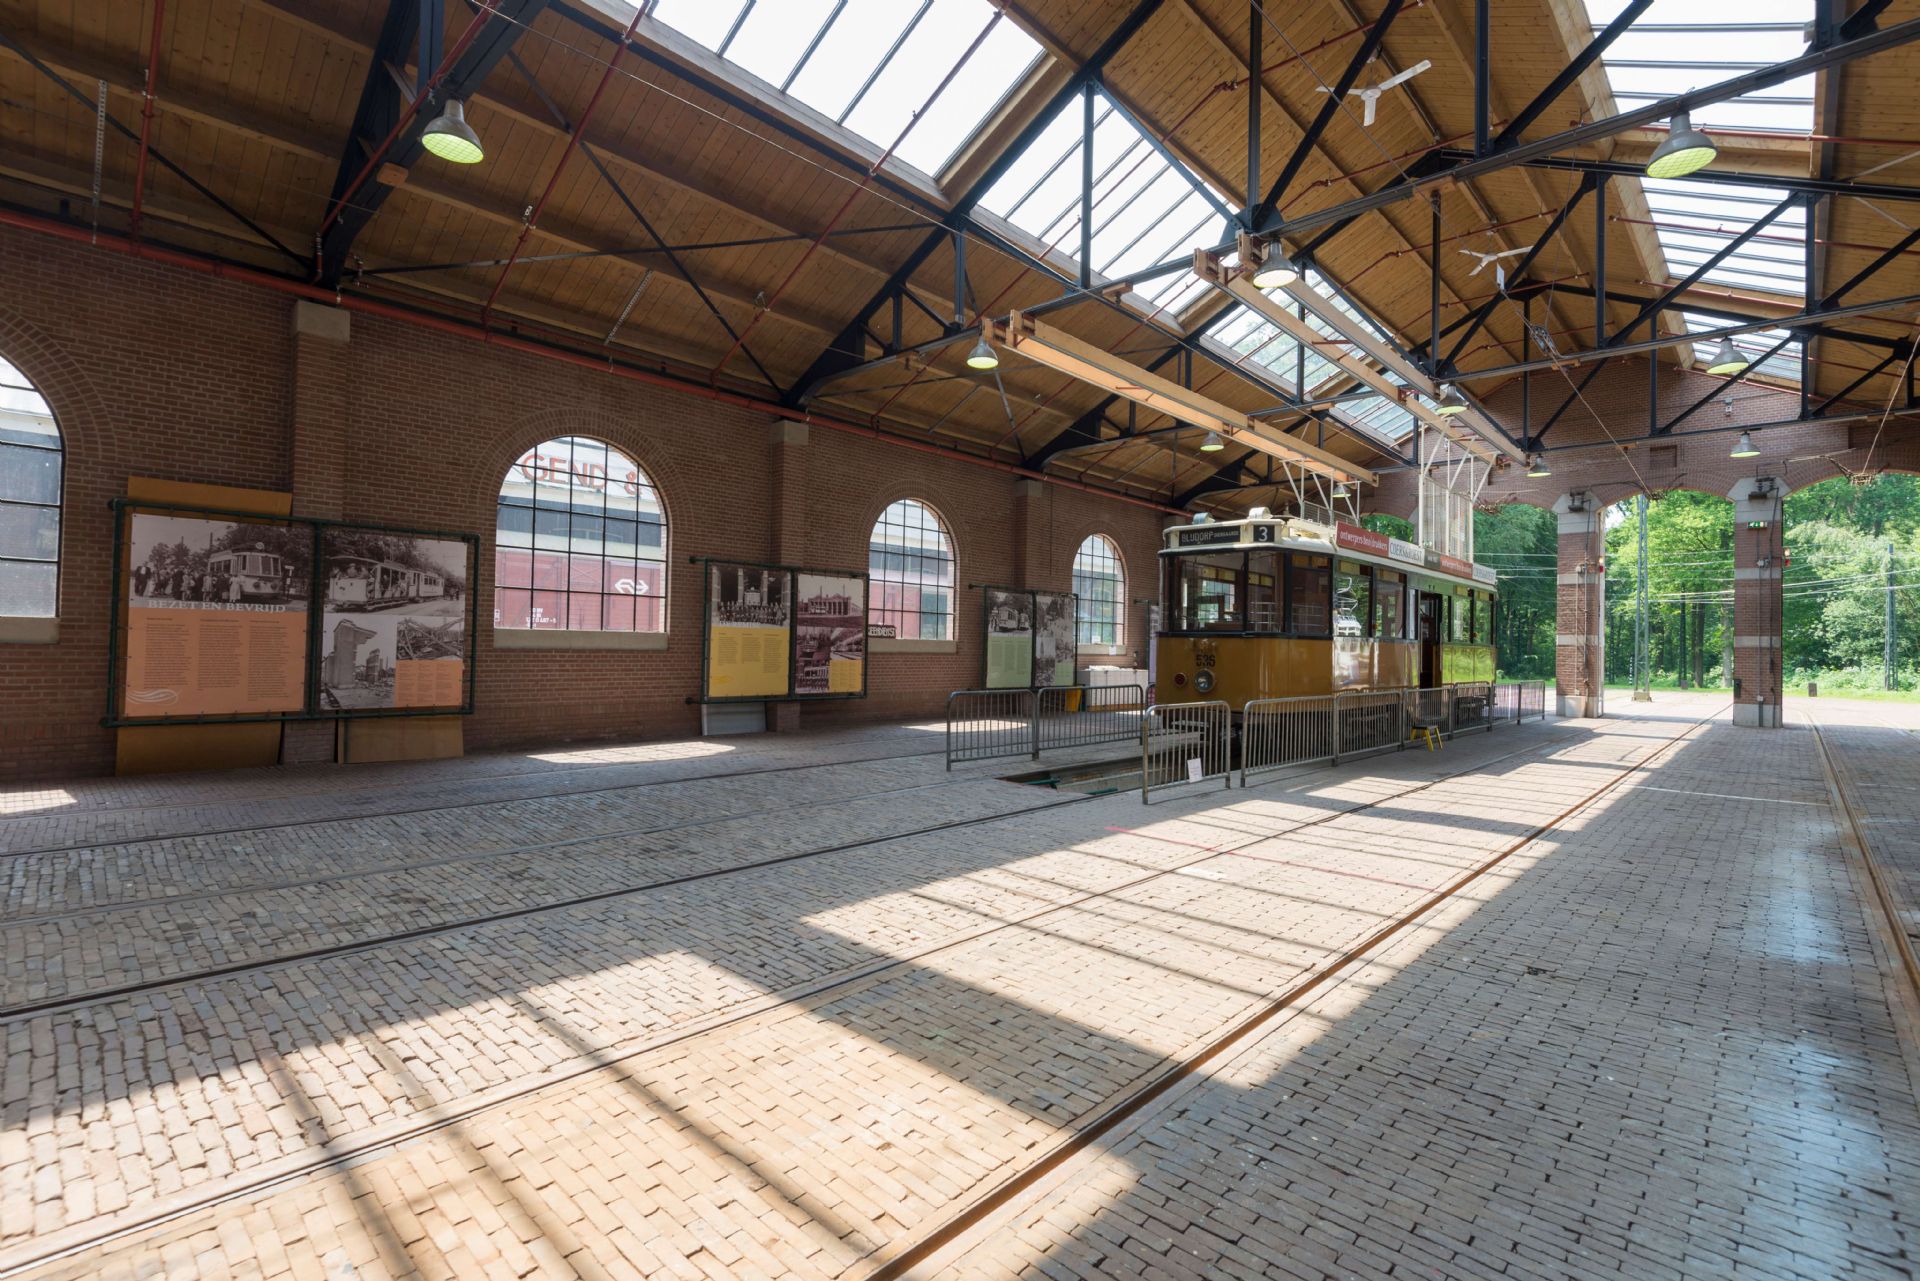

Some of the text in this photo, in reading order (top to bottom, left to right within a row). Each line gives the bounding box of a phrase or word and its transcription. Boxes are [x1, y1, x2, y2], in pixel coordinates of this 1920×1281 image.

[521, 454, 608, 489] GEND
[1258, 526, 1268, 542] 3
[147, 599, 286, 613] BEZET EN BEVRIJD
[1196, 654, 1216, 667] 536
